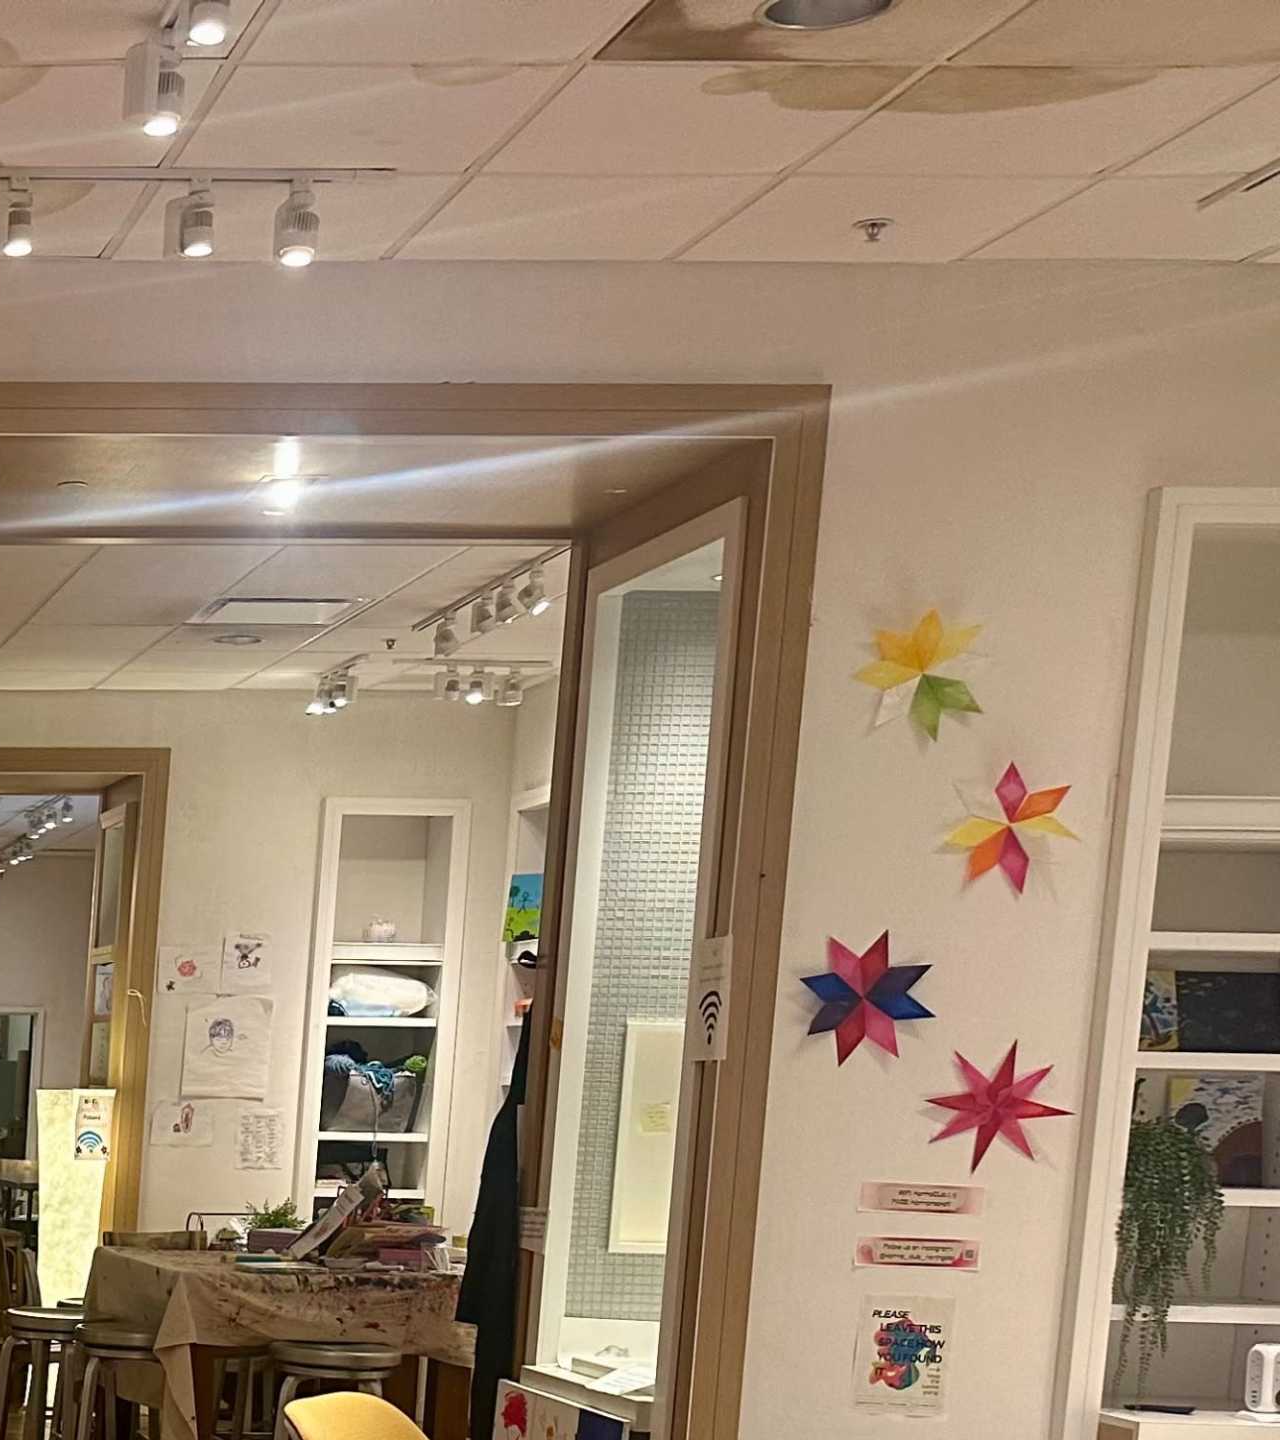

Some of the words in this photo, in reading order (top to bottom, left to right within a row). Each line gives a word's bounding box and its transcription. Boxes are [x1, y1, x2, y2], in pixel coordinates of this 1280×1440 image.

[872, 1309, 910, 1319] PLEASE
[880, 1322, 914, 1333] LEAVE
[918, 1324, 942, 1334] THIS
[878, 1338, 916, 1348] SPACE
[917, 1339, 945, 1349] HOW
[877, 1351, 903, 1361] YOU
[904, 1353, 942, 1364] FOUND
